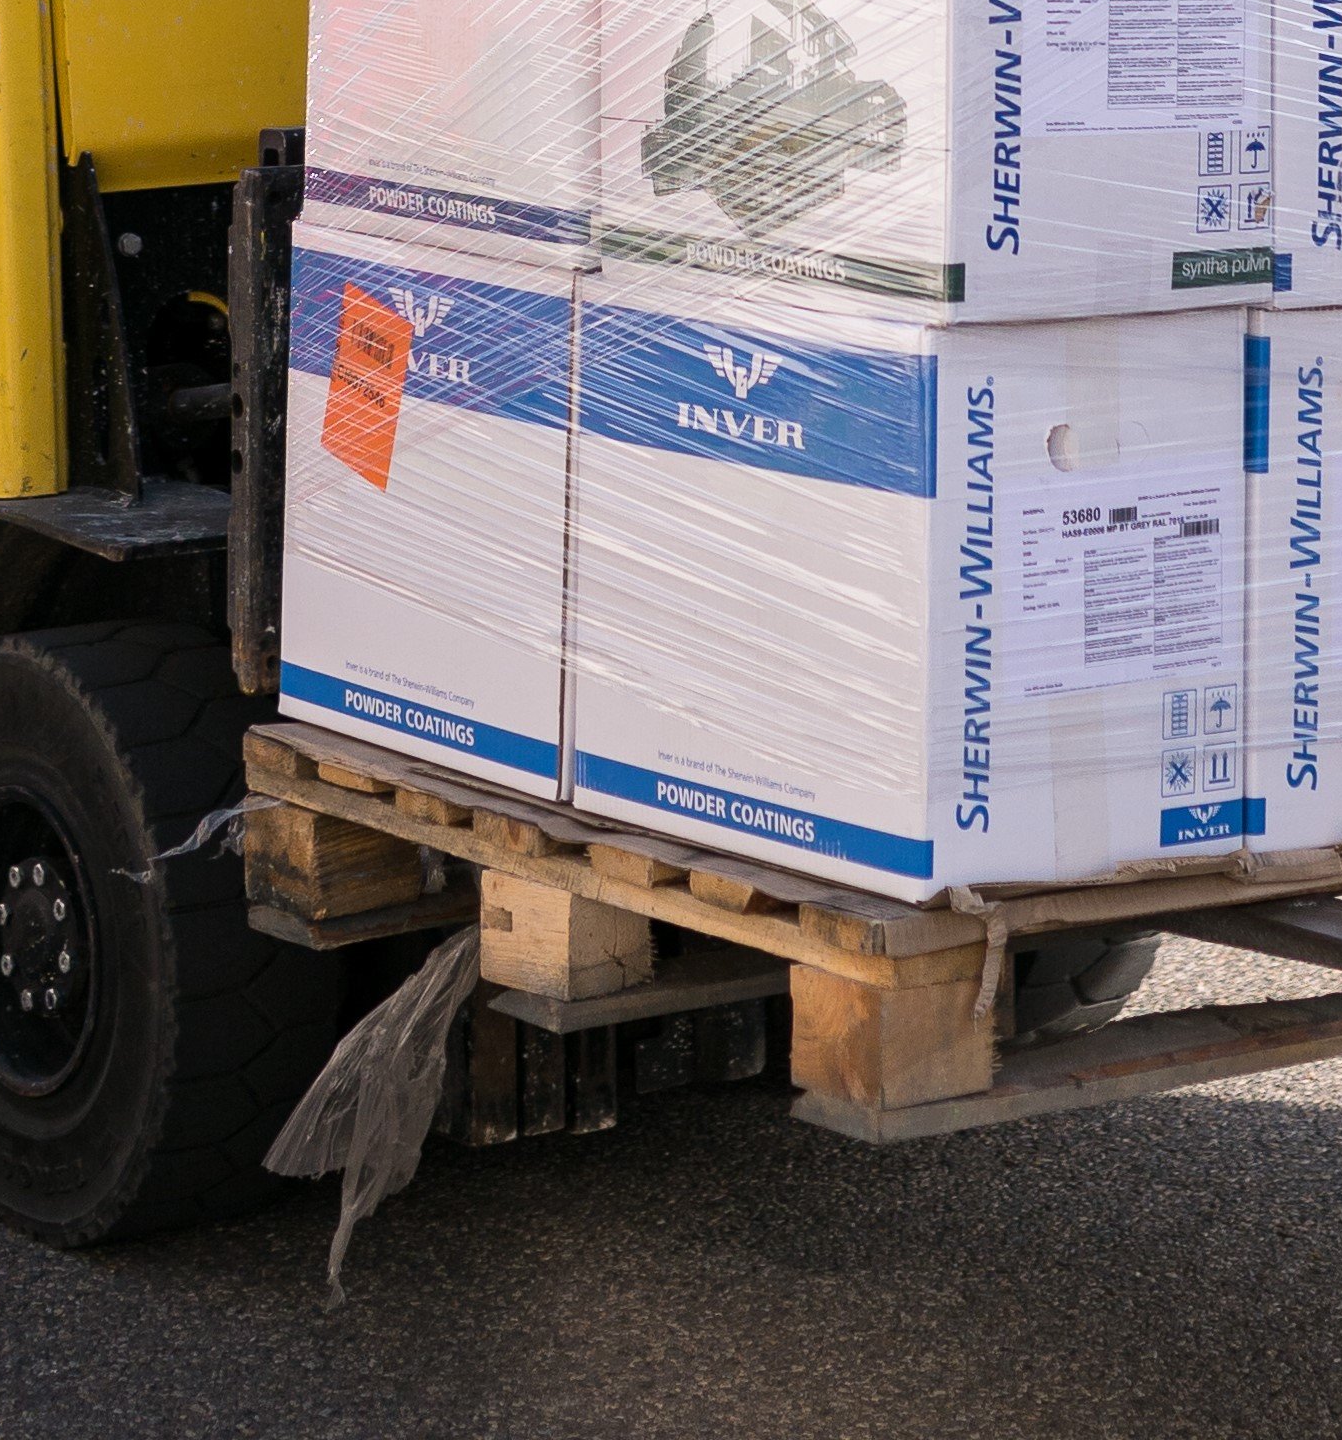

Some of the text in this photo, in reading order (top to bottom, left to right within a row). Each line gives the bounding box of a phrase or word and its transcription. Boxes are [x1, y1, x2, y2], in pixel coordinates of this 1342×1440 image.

[369, 185, 496, 225] POWDER COATINGS
[686, 241, 846, 282] POWDER COATINGS
[1182, 253, 1271, 280] syntha pulvin
[407, 348, 471, 384] VER
[675, 400, 805, 451] INVER
[1062, 506, 1101, 526] 53680
[1119, 523, 1129, 533] BT
[1130, 522, 1151, 531] GREY
[1152, 519, 1167, 528] RAL
[368, 667, 384, 681] brand
[385, 671, 391, 681] of
[391, 673, 402, 686] The
[448, 691, 475, 711] Company
[345, 689, 475, 747] POWDER COATINGS
[685, 757, 705, 771] brand
[705, 761, 713, 774] of
[714, 763, 727, 777] The
[784, 782, 816, 803] Company
[657, 780, 815, 843] POWDER COATINGS
[1177, 825, 1230, 841] INVER
